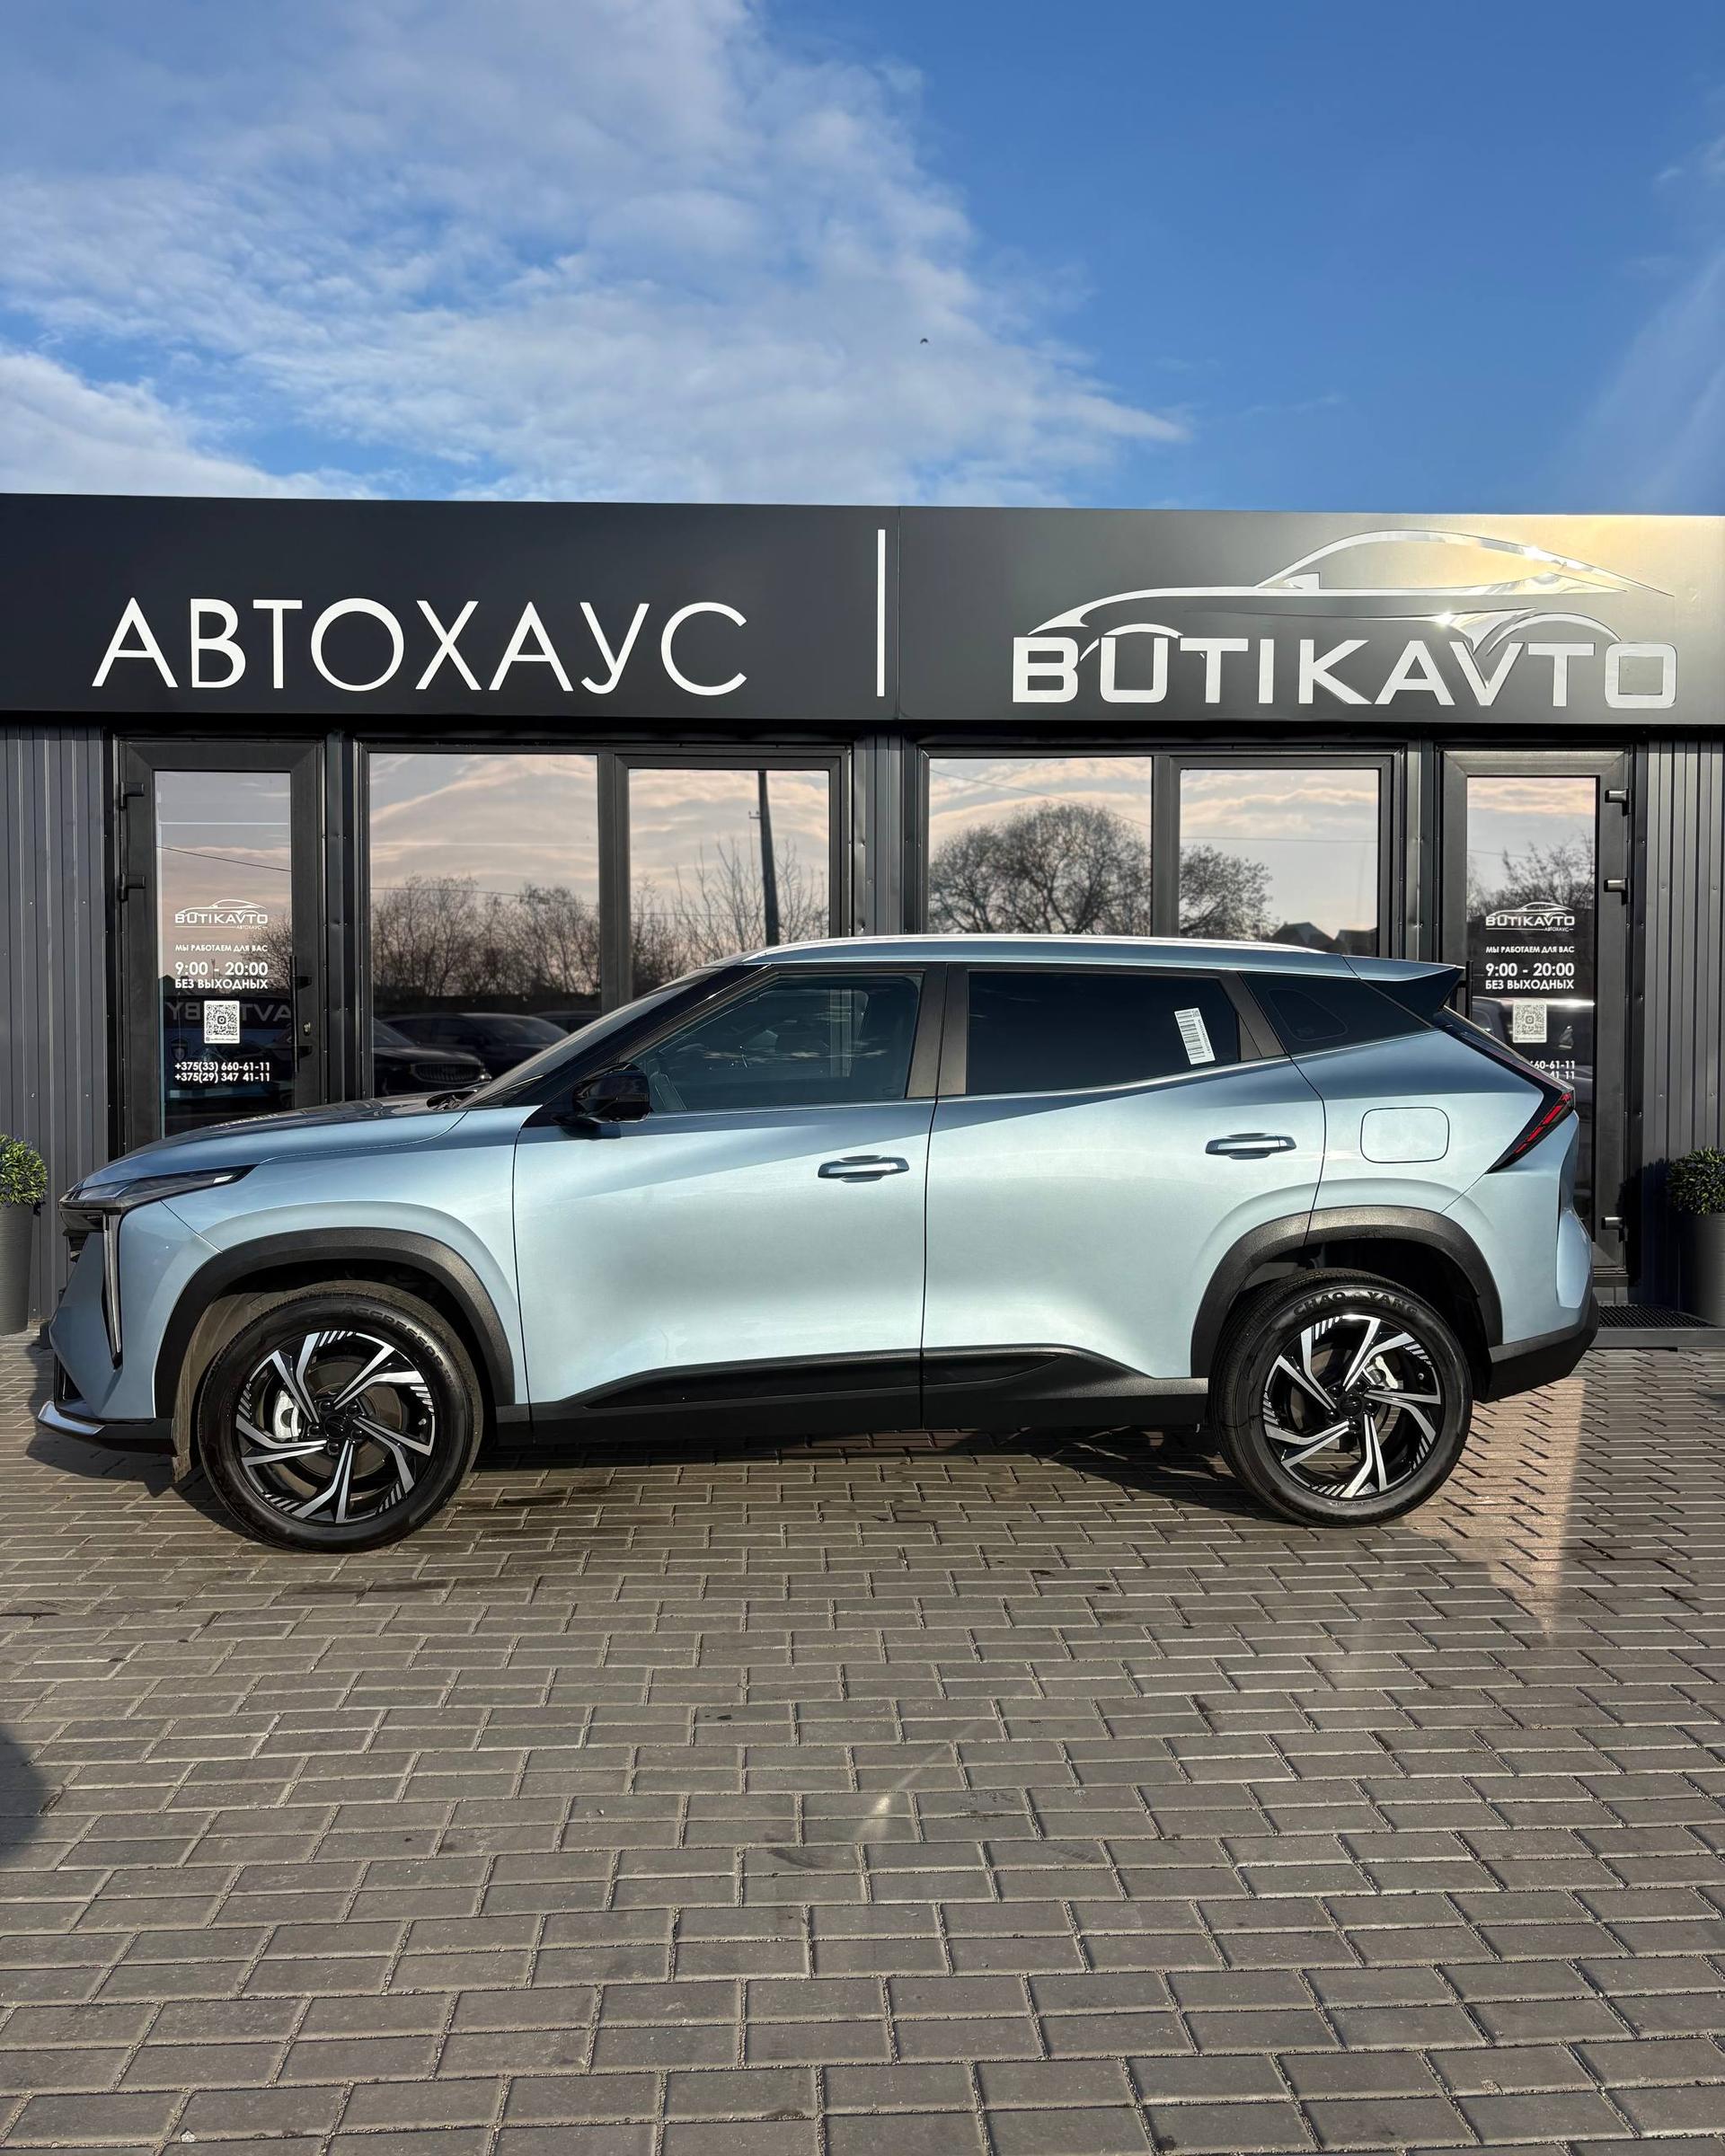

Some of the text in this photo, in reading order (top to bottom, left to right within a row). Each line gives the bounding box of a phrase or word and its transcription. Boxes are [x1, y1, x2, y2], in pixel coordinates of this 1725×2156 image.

[91, 596, 748, 695] АВТОХАУС
[1012, 636, 1677, 708] BUTIKAVTO
[174, 913, 269, 924] BUTIKAVTO
[1485, 915, 1575, 927] BUTIKAVTO
[174, 944, 269, 952] МЫ РАБОТАЕМ ДЛЯ ВАС
[1485, 946, 1575, 954] МЫ РАБОТАЕМ ДЛЯ ВАС
[174, 961, 208, 976] 9:00
[225, 961, 269, 976] 20:00
[1485, 963, 1518, 976] 9:00
[1533, 963, 1575, 976] 20:00
[174, 978, 269, 990] БЕЗ ВЫХОДНЫХ
[1485, 979, 1575, 990] БЕЗ ВЫХОДНЫХ
[174, 1062, 270, 1073] +375(33) 660-61-11
[1529, 1060, 1575, 1070] 60-61-11
[174, 1072, 270, 1083] +375(29) 347 41-11
[1293, 1291, 1419, 1317] CHAO YANG
